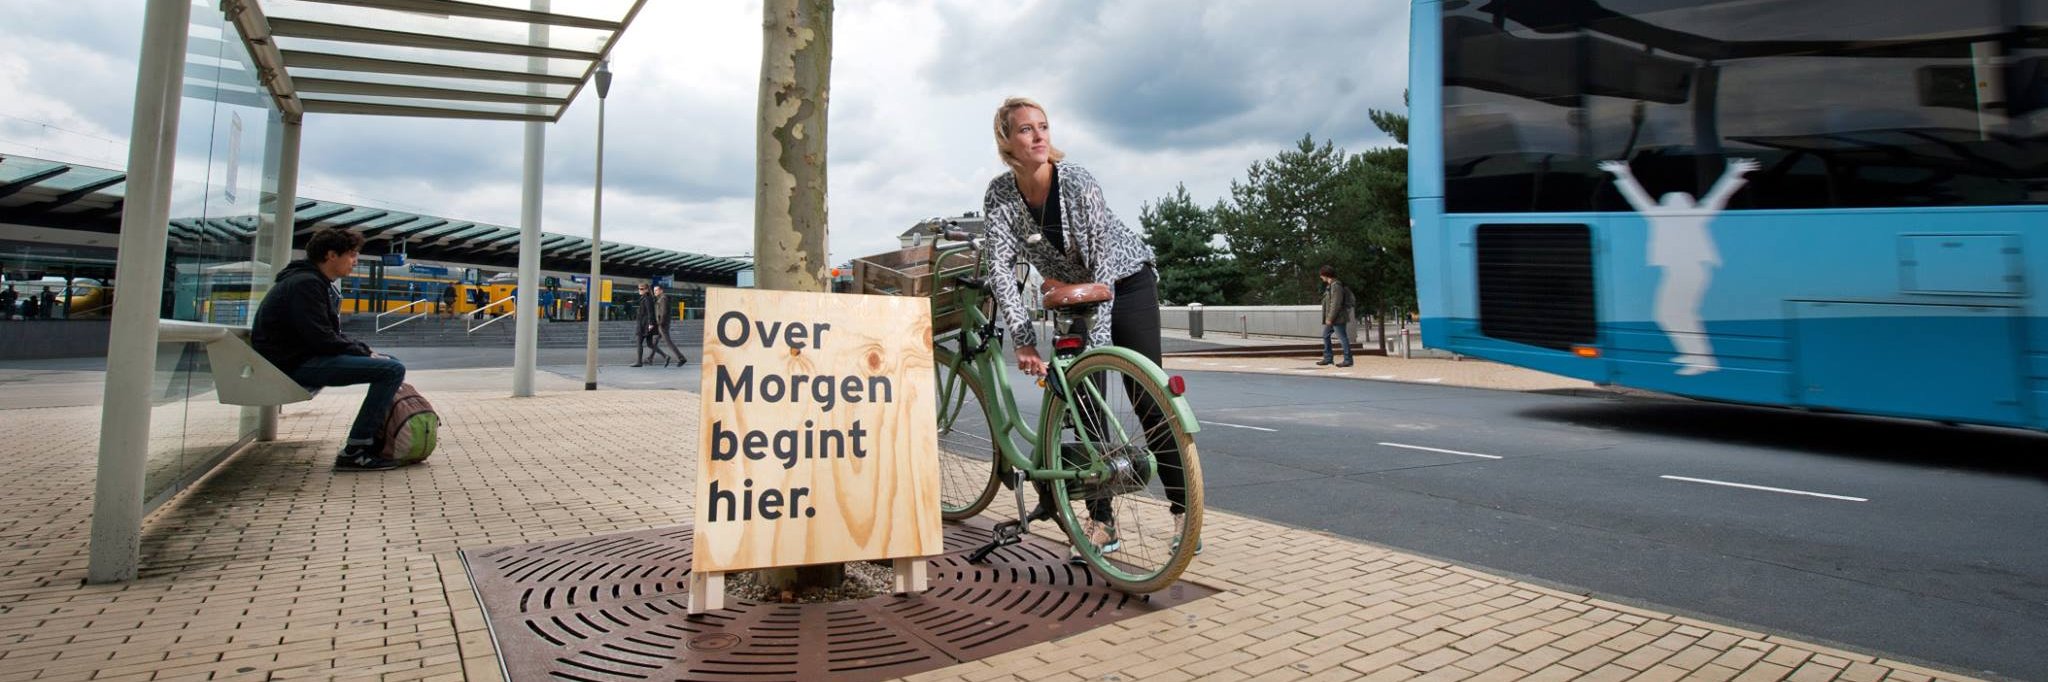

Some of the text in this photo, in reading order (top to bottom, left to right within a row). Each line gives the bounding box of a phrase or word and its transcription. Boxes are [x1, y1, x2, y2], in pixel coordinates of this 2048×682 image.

[717, 311, 830, 349] Over
[715, 365, 892, 411] Morgen
[711, 420, 867, 469] begint
[708, 479, 816, 522] hier.
